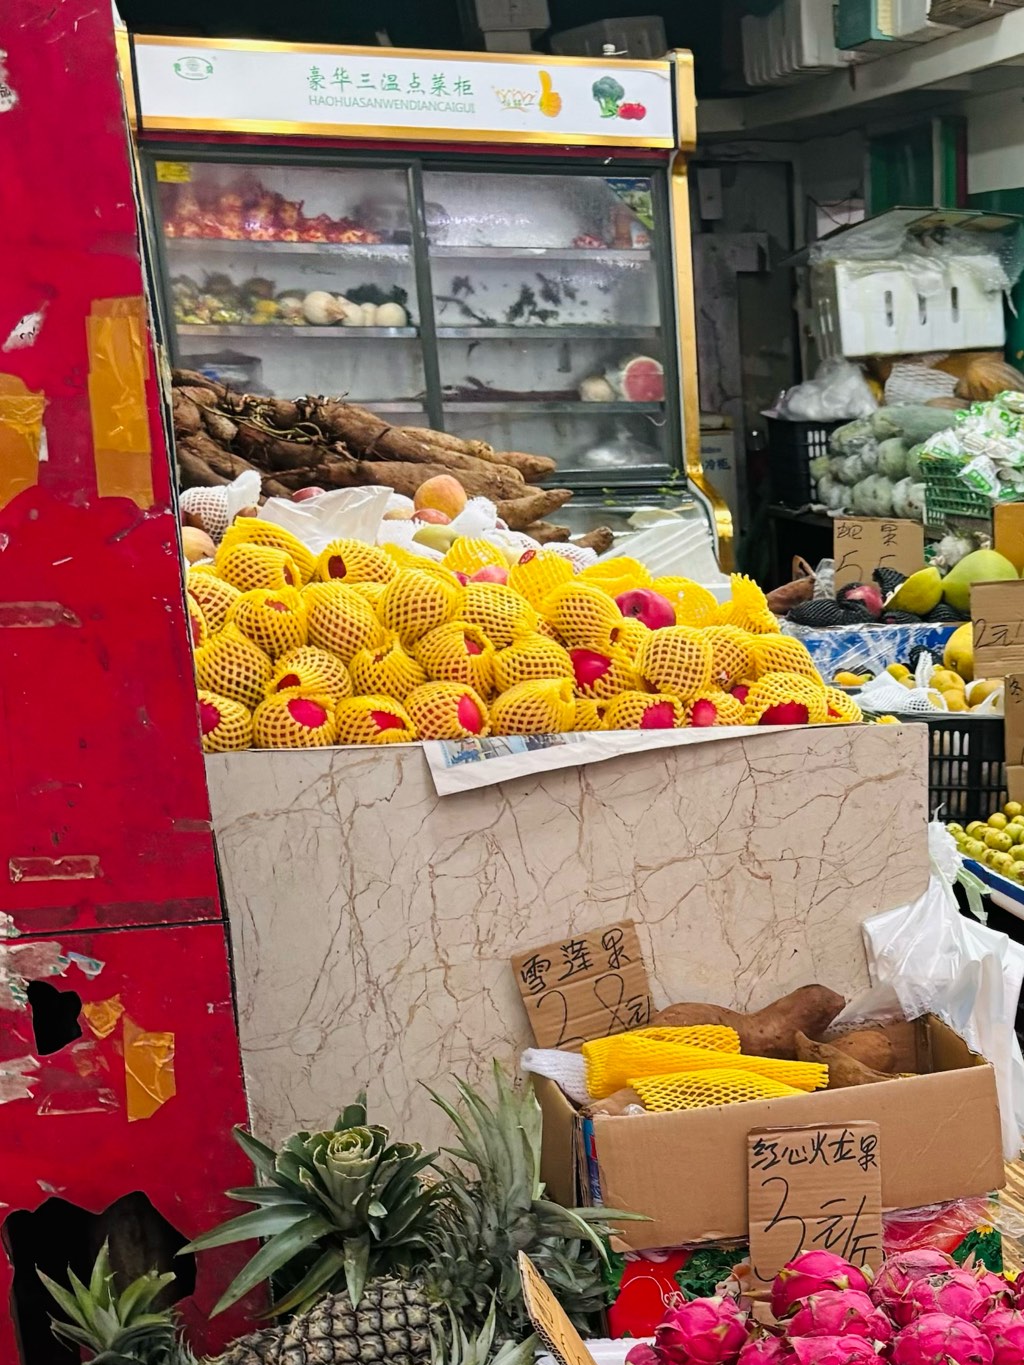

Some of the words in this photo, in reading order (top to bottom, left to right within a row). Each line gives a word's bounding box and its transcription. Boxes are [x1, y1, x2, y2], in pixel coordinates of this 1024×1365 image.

[307, 65, 475, 97] 豪华三温点菜柜
[308, 94, 477, 114] HAOHUASANWENDIANCAIGUI
[520, 928, 632, 995] 雪莲果
[751, 1129, 878, 1171] 红心火龙果
